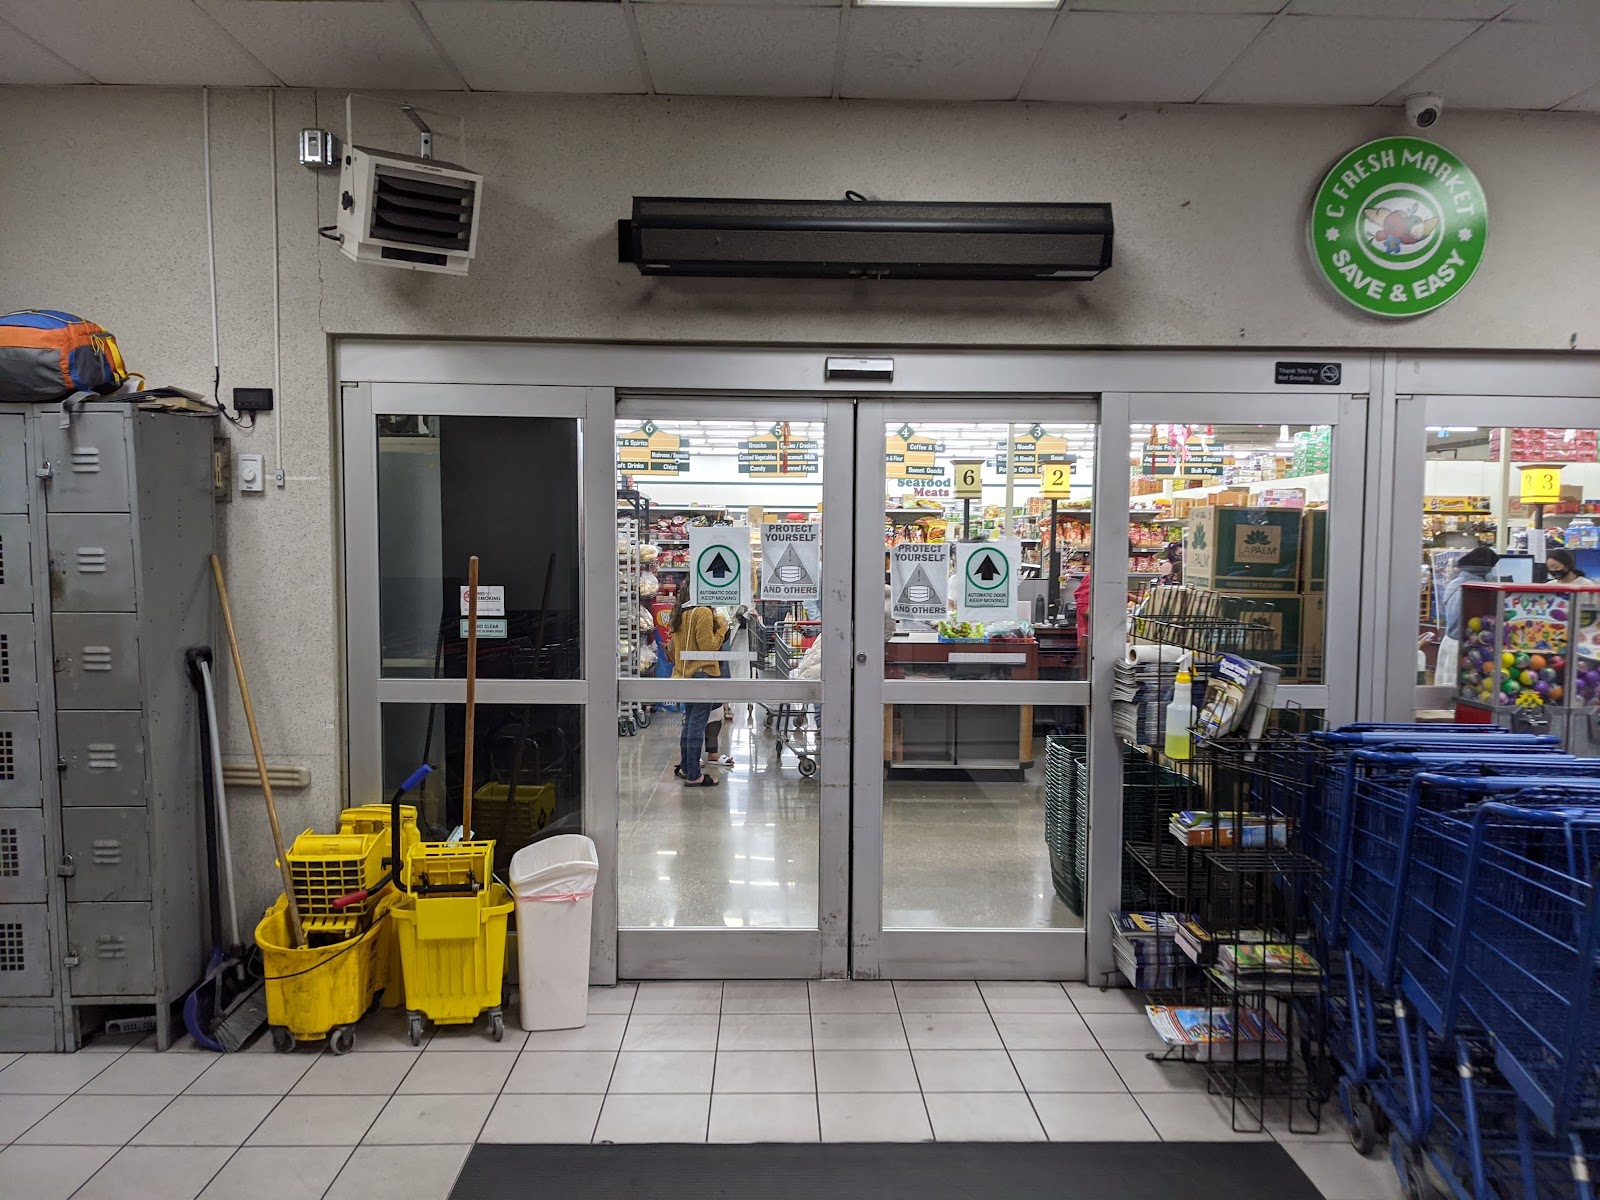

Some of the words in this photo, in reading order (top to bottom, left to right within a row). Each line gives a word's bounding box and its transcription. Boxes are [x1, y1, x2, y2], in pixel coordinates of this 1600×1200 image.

[1332, 149, 1396, 200] FRESH
[1401, 148, 1476, 216] MARKET
[1326, 203, 1345, 219] C
[1331, 248, 1387, 300] SAVE
[1389, 283, 1408, 302] &
[1411, 248, 1466, 300] EASY
[1289, 374, 1315, 383] Smoking
[645, 422, 654, 433] 6
[774, 425, 781, 436] 5
[901, 427, 910, 438] 4
[1033, 426, 1042, 438] 3
[630, 439, 649, 447] Spirits
[749, 465, 767, 473] Candy
[1018, 466, 1034, 474] Chips
[963, 469, 976, 486] 6
[1052, 469, 1064, 486] 2
[1542, 474, 1553, 490] 3
[897, 478, 951, 488] Seafood
[914, 487, 950, 497] Meats
[769, 524, 813, 533] PROTECT
[765, 533, 817, 542] YOURSELF
[898, 544, 942, 553] PROTECT
[1250, 547, 1275, 555] PALM
[895, 553, 946, 562] YOURSELF
[763, 586, 782, 594] AND
[783, 586, 818, 594] OTHERS
[893, 605, 910, 613] AND
[911, 606, 947, 614] OTHERS
